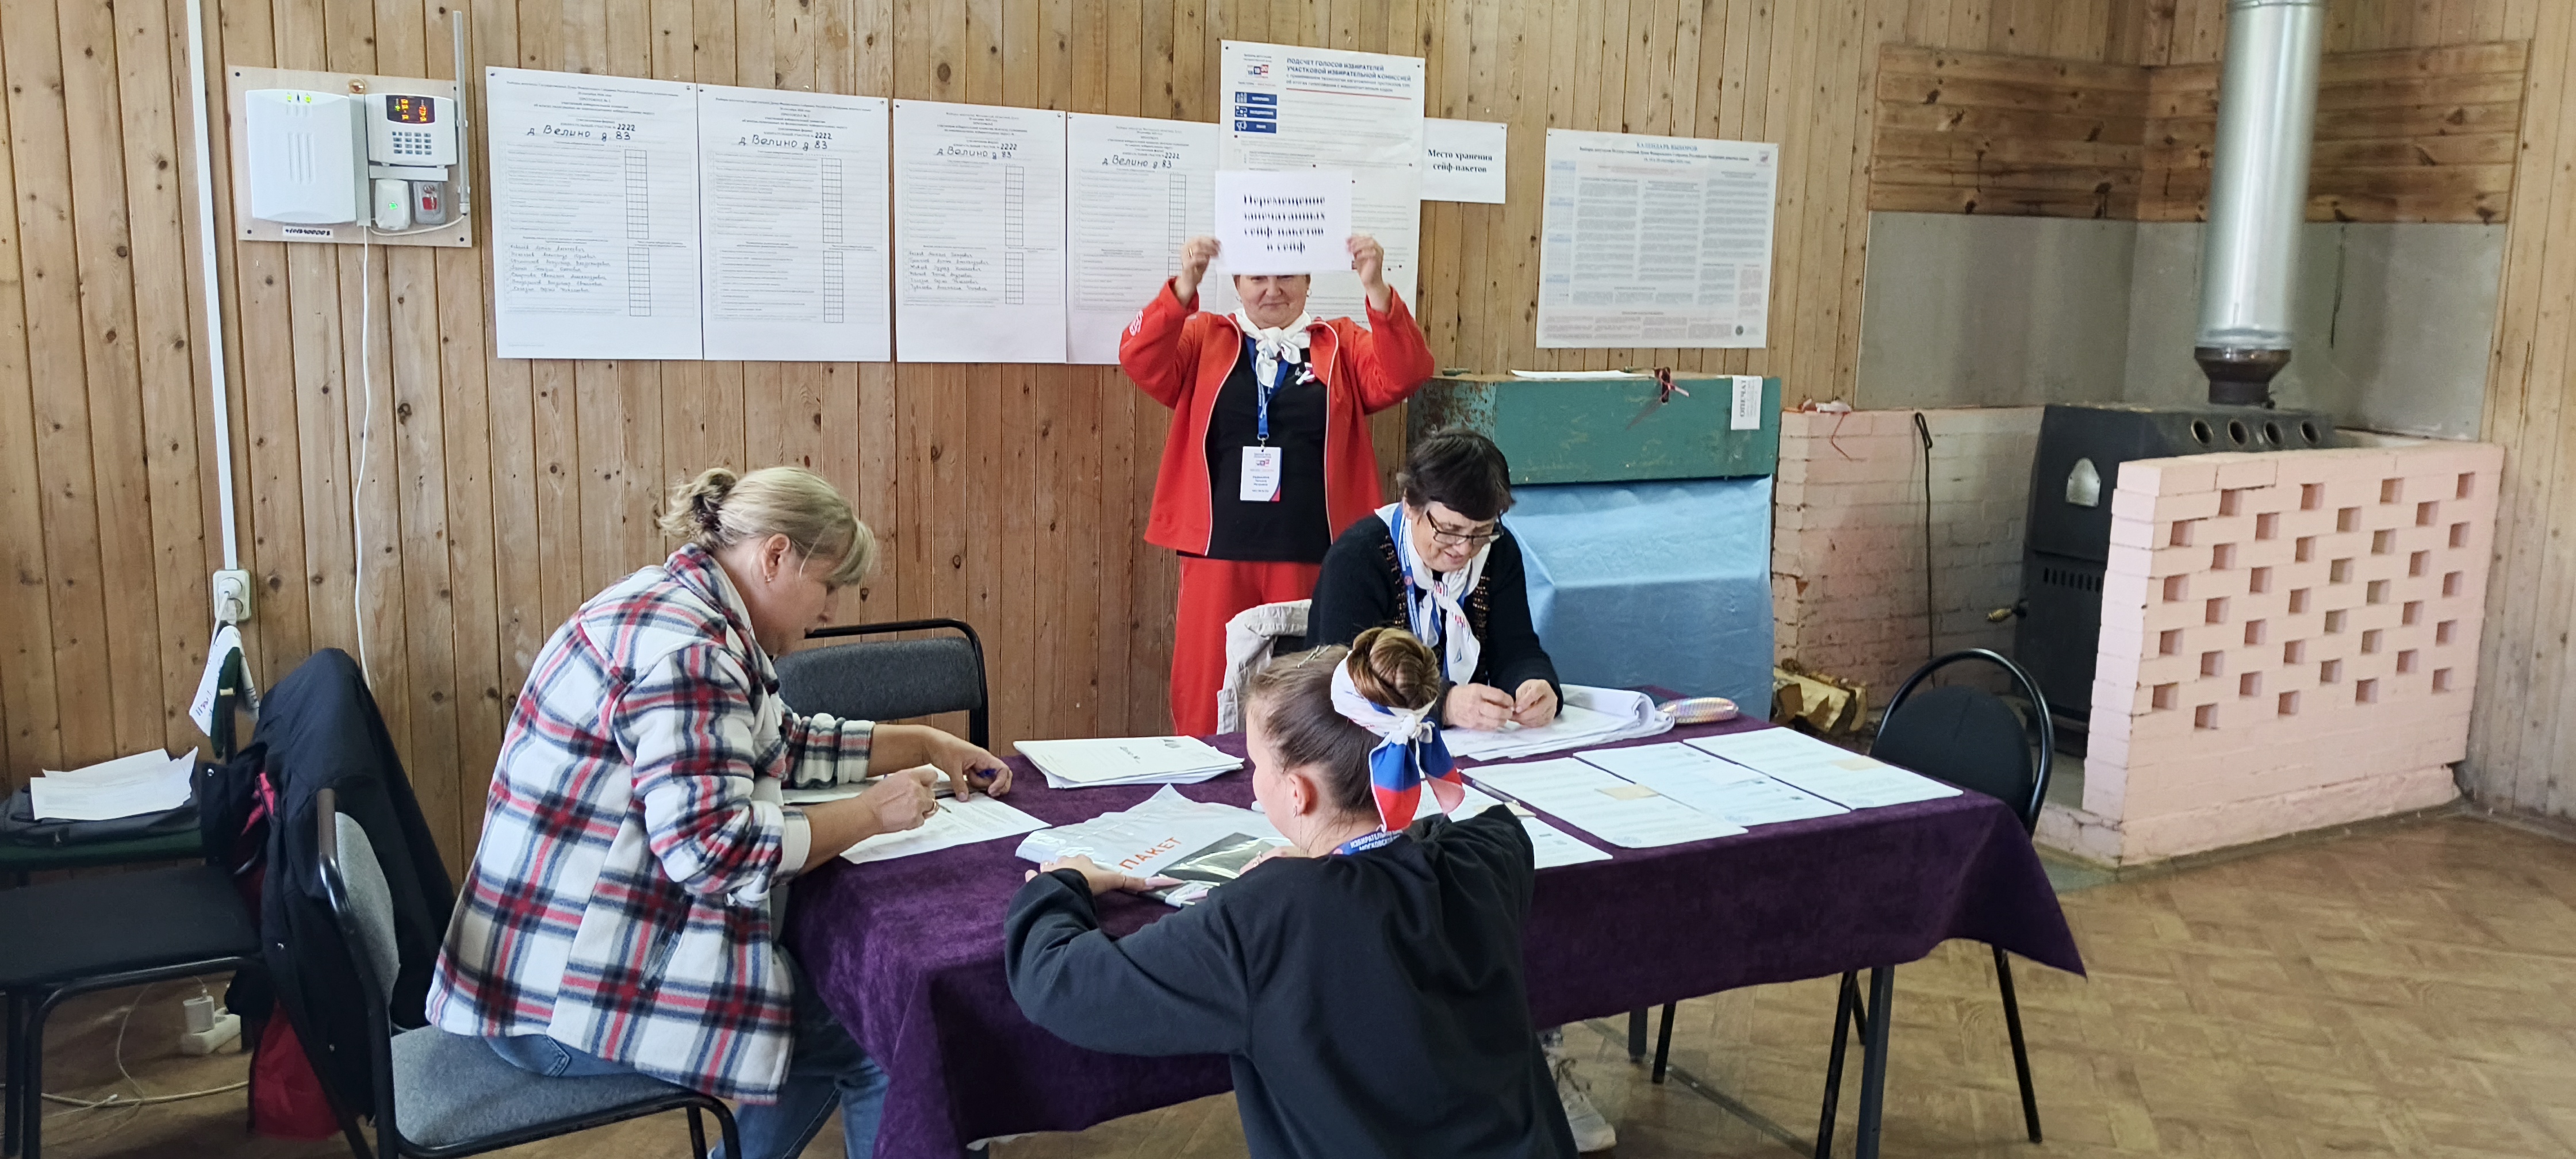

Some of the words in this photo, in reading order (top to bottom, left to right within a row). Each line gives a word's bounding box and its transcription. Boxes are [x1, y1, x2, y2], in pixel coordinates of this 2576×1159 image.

[1287, 57, 1314, 66] ПОДСЧЕТ
[1344, 63, 1384, 71] ИЗБИРАТЕЛЕЙ
[1287, 66, 1326, 74] УЧАСТКОВОЙ
[1328, 70, 1376, 78] ИЗБИРАТЕЛЬНОЙ
[1377, 74, 1411, 82] КОМИССИЕЙ
[543, 125, 591, 137] Велино
[616, 131, 631, 140] 83
[617, 124, 635, 132] 2222
[752, 135, 798, 148] Велино
[814, 140, 827, 149] 83
[947, 145, 988, 158] Велино
[1428, 149, 1453, 158] Место
[1455, 152, 1492, 161] хранения
[1112, 154, 1148, 167] Велино
[1162, 159, 1172, 168] 83
[1433, 162, 1487, 172] сейф-пакетов
[1244, 194, 1325, 209] Перемещение
[1277, 240, 1305, 255] сейф
[1118, 836, 1182, 870] ПАКЕТ
